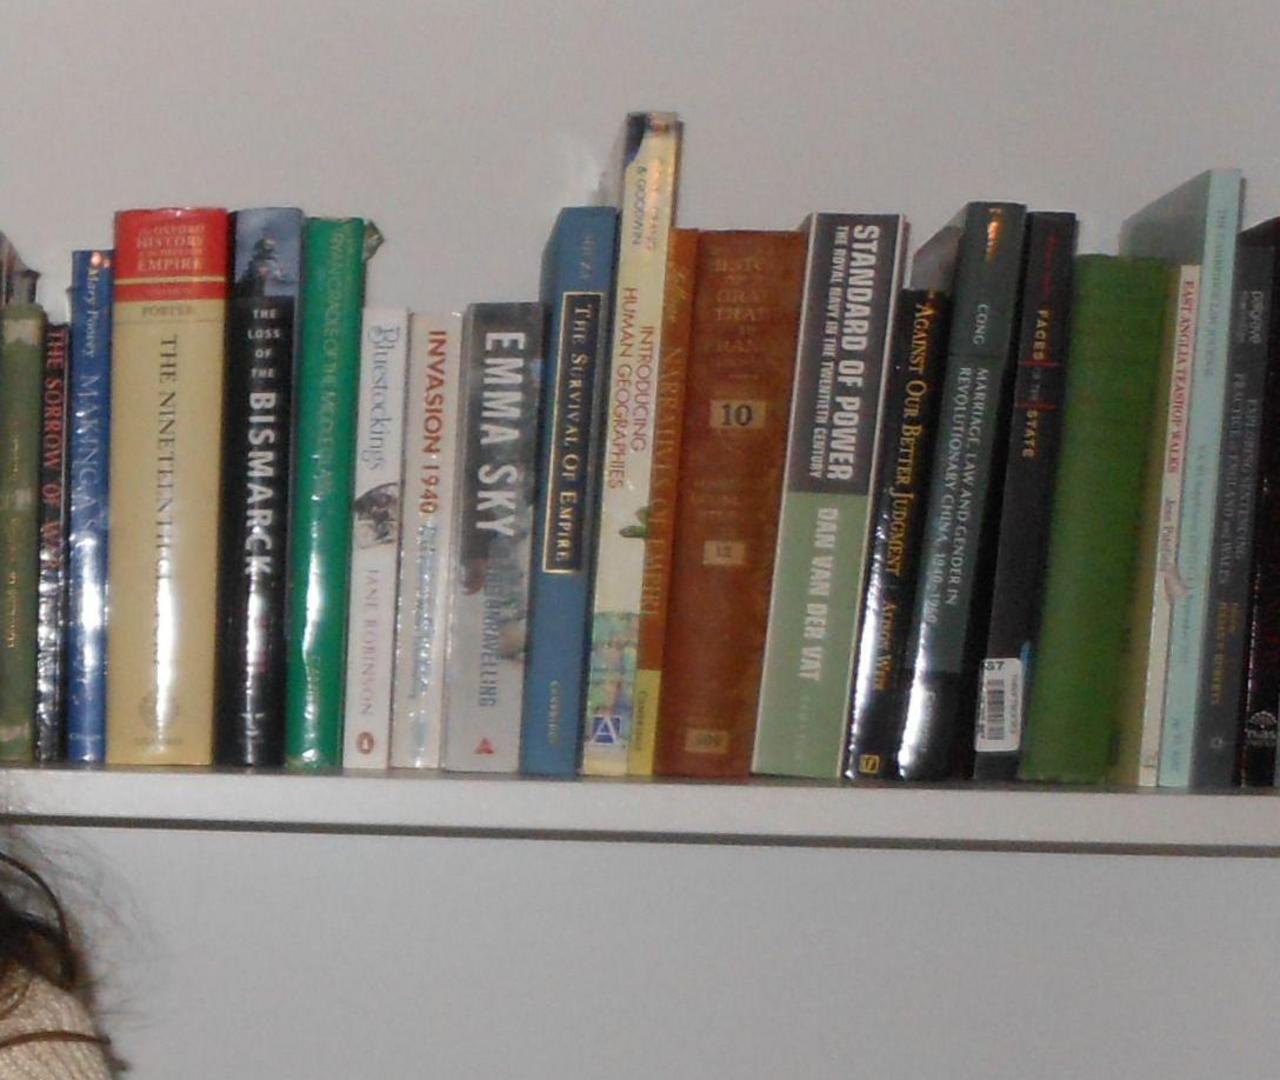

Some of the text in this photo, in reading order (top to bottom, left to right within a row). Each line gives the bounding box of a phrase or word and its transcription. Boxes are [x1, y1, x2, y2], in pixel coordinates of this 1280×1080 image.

[609, 287, 637, 489] HUMAN GEOGRAPHIES
[631, 326, 655, 454] INTRODUCING
[721, 405, 753, 425] 10
[810, 225, 849, 478] THE ROYAL NAVY IN THE TWENTIETH CENTURY
[828, 225, 879, 480] STANDARD OF POWER
[972, 304, 988, 345] CONG
[1031, 309, 1049, 361] FACES
[1167, 281, 1194, 474] EAST ANGLIA TEASHOP WALKS
[155, 337, 178, 549] THE NINETEENTH
[244, 392, 276, 577] BISMARCK
[419, 330, 447, 515] INVASION 1940
[476, 331, 524, 537] EMMA SKY
[554, 304, 593, 563] THE SURVIVAL OF EMPIRE
[944, 367, 987, 605] MARRIAGE, LAW AND GENDER IN
[1022, 409, 1037, 458] STATE
[360, 569, 379, 716] JANE ROBINSON
[796, 508, 838, 681] DAN VAN DER VAT
